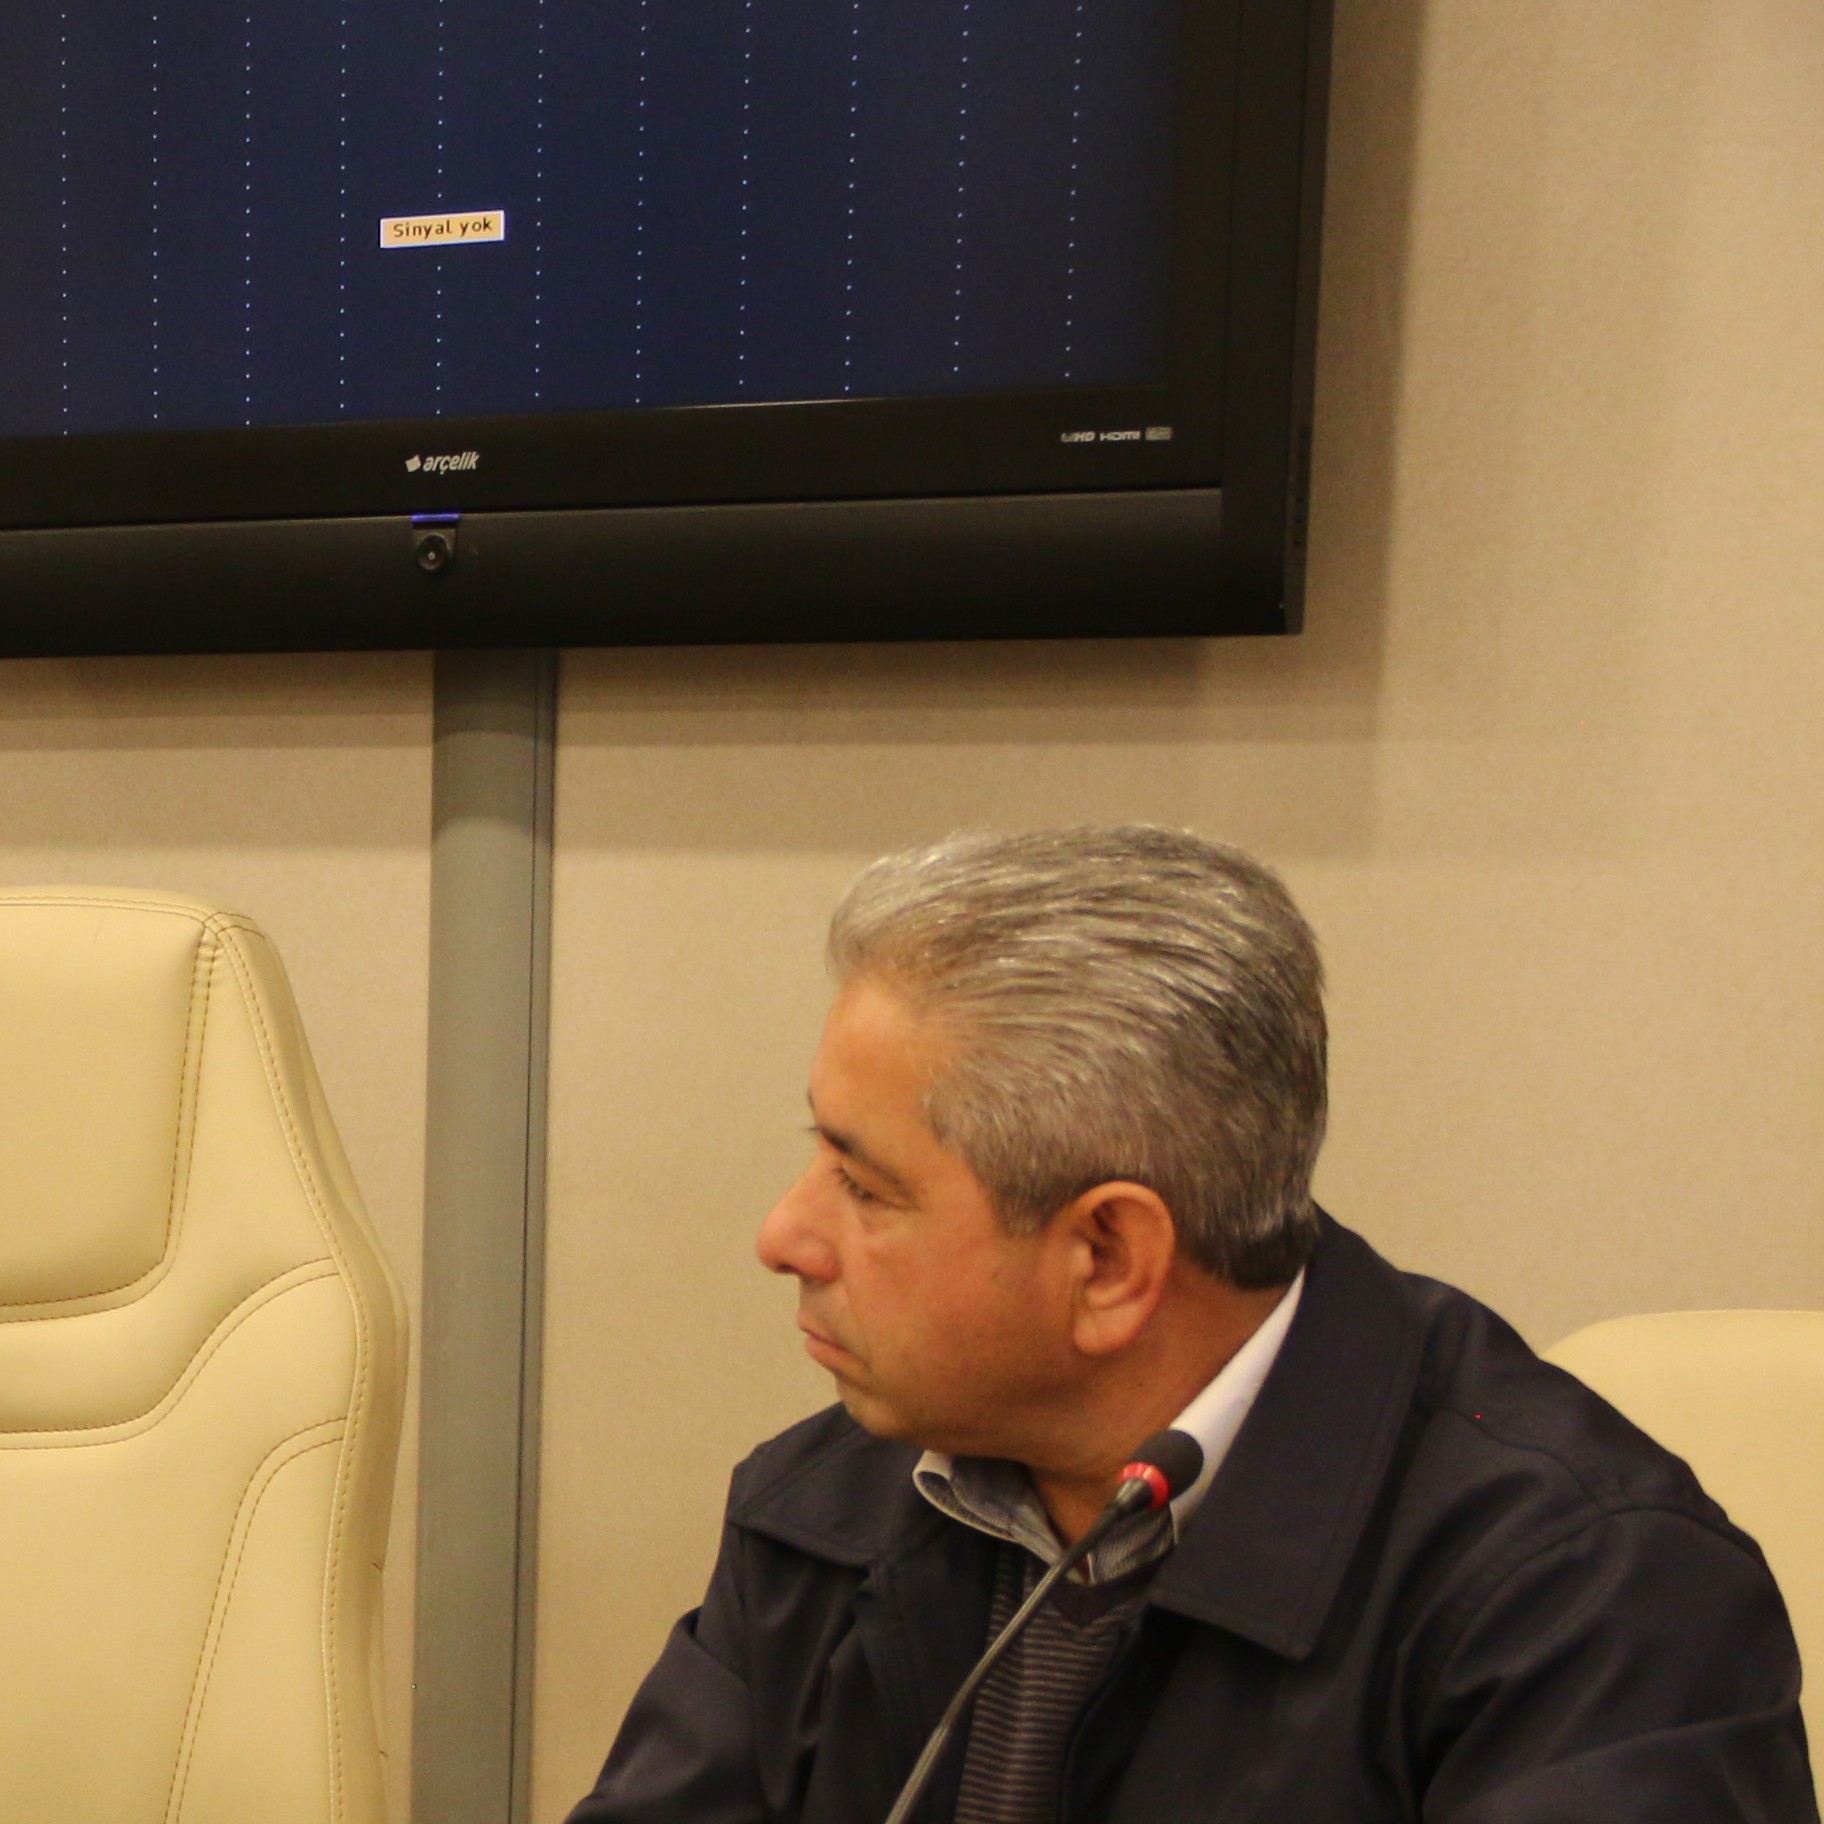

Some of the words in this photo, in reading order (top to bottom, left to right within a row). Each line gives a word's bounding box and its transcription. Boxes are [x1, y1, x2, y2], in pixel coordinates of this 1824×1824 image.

[393, 219, 453, 240] Sinyal
[459, 217, 492, 236] yok
[423, 451, 480, 475] arçelik
